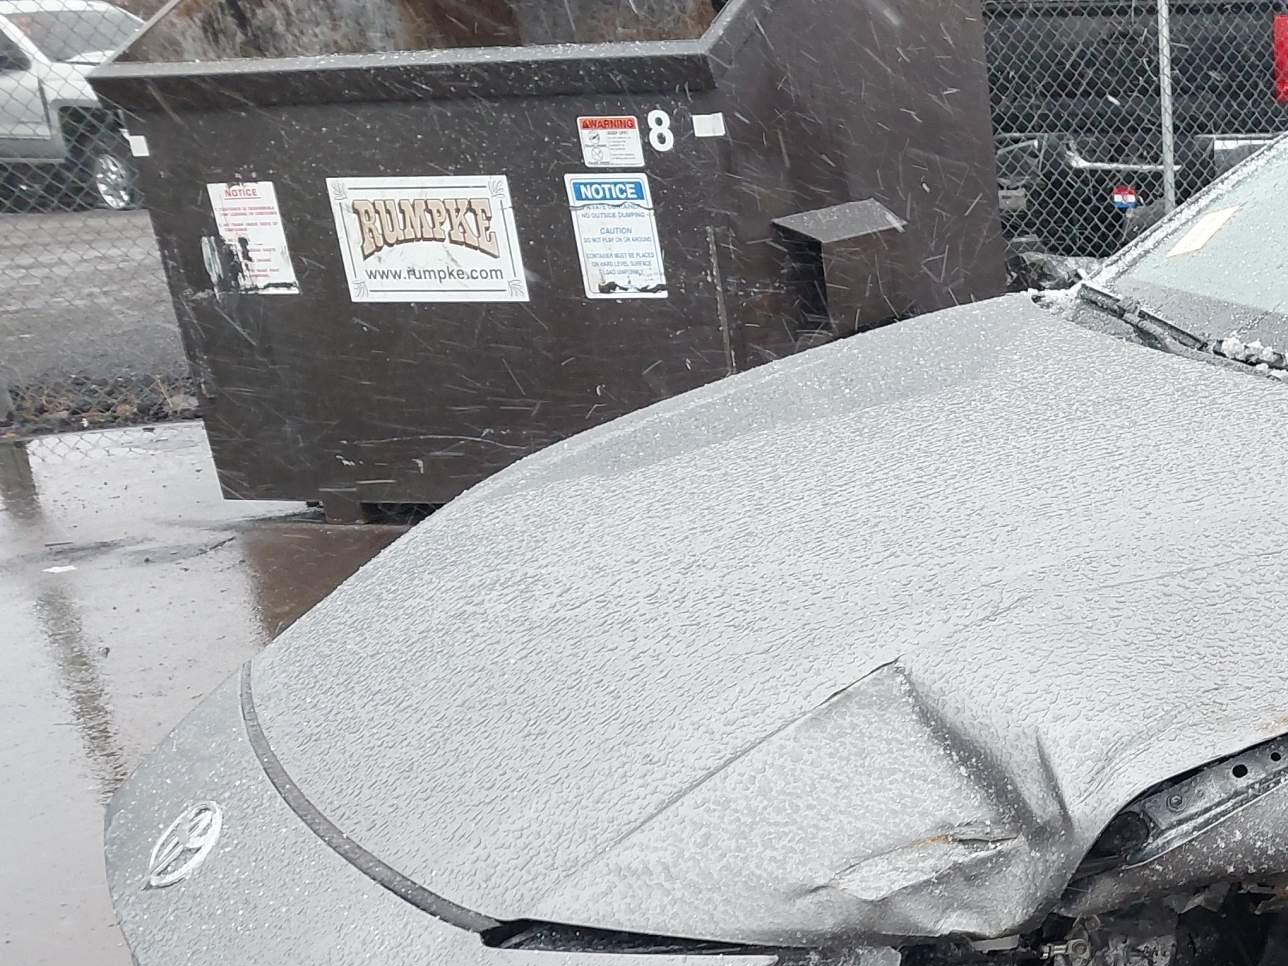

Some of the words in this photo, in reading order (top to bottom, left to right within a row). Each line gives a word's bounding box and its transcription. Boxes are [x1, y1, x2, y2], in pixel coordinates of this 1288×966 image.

[588, 119, 634, 129] WARNING
[647, 109, 675, 152] 8
[224, 188, 257, 197] NOTICE
[580, 183, 638, 199] NOTICE
[351, 197, 500, 261] RUMPKE
[600, 227, 632, 235] CAUTION
[365, 266, 503, 284] www.rumpke.com
